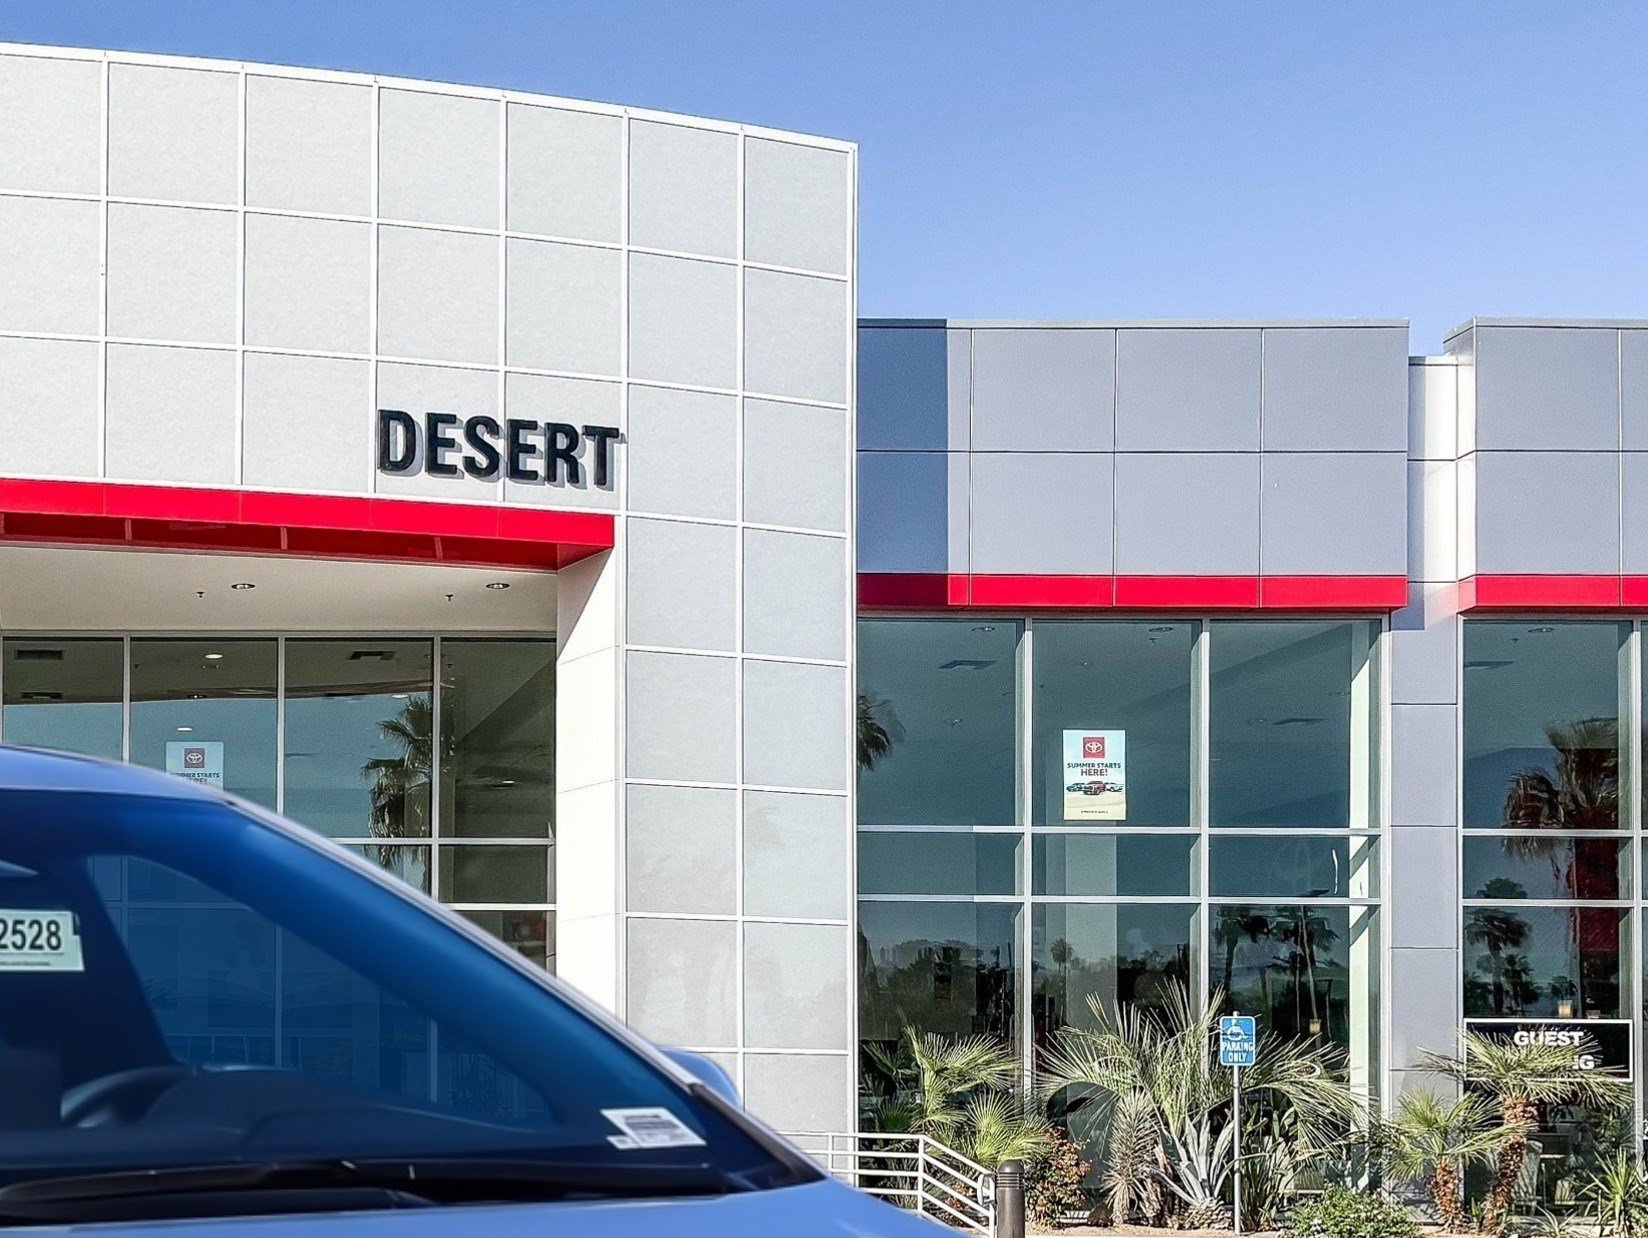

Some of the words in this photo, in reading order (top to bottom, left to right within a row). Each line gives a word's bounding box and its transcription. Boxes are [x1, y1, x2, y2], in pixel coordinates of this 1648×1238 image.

[377, 408, 620, 486] DESERT
[1080, 768, 1108, 776] HERE!
[1513, 1030, 1584, 1047] GUEST
[1222, 1040, 1254, 1051] PARKING
[1228, 1051, 1247, 1063] ONLY
